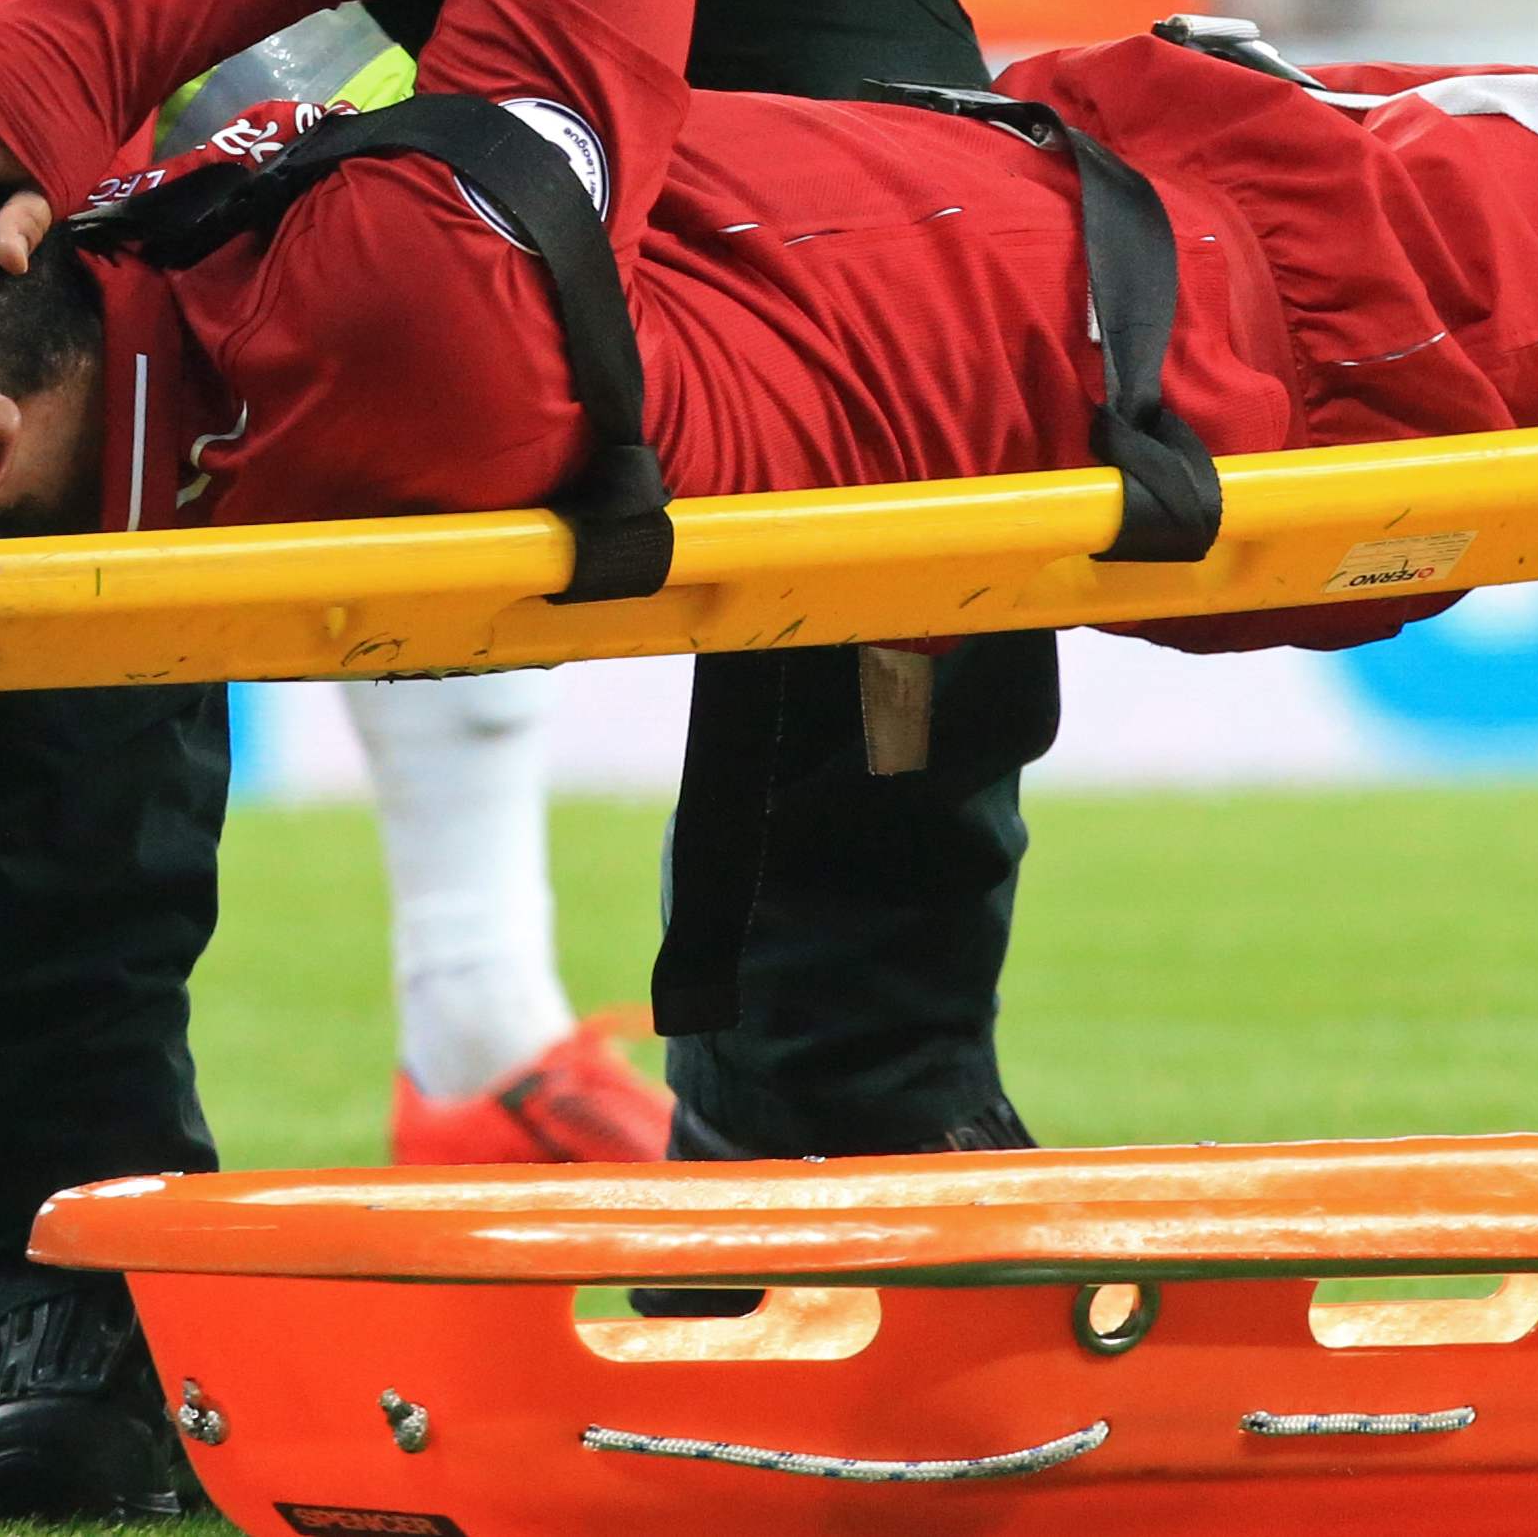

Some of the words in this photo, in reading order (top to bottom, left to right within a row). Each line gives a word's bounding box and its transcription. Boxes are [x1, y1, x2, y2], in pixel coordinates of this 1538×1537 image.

[563, 127, 597, 177] League
[1348, 568, 1419, 587] FERNO
[292, 1507, 444, 1536] SPENCER
